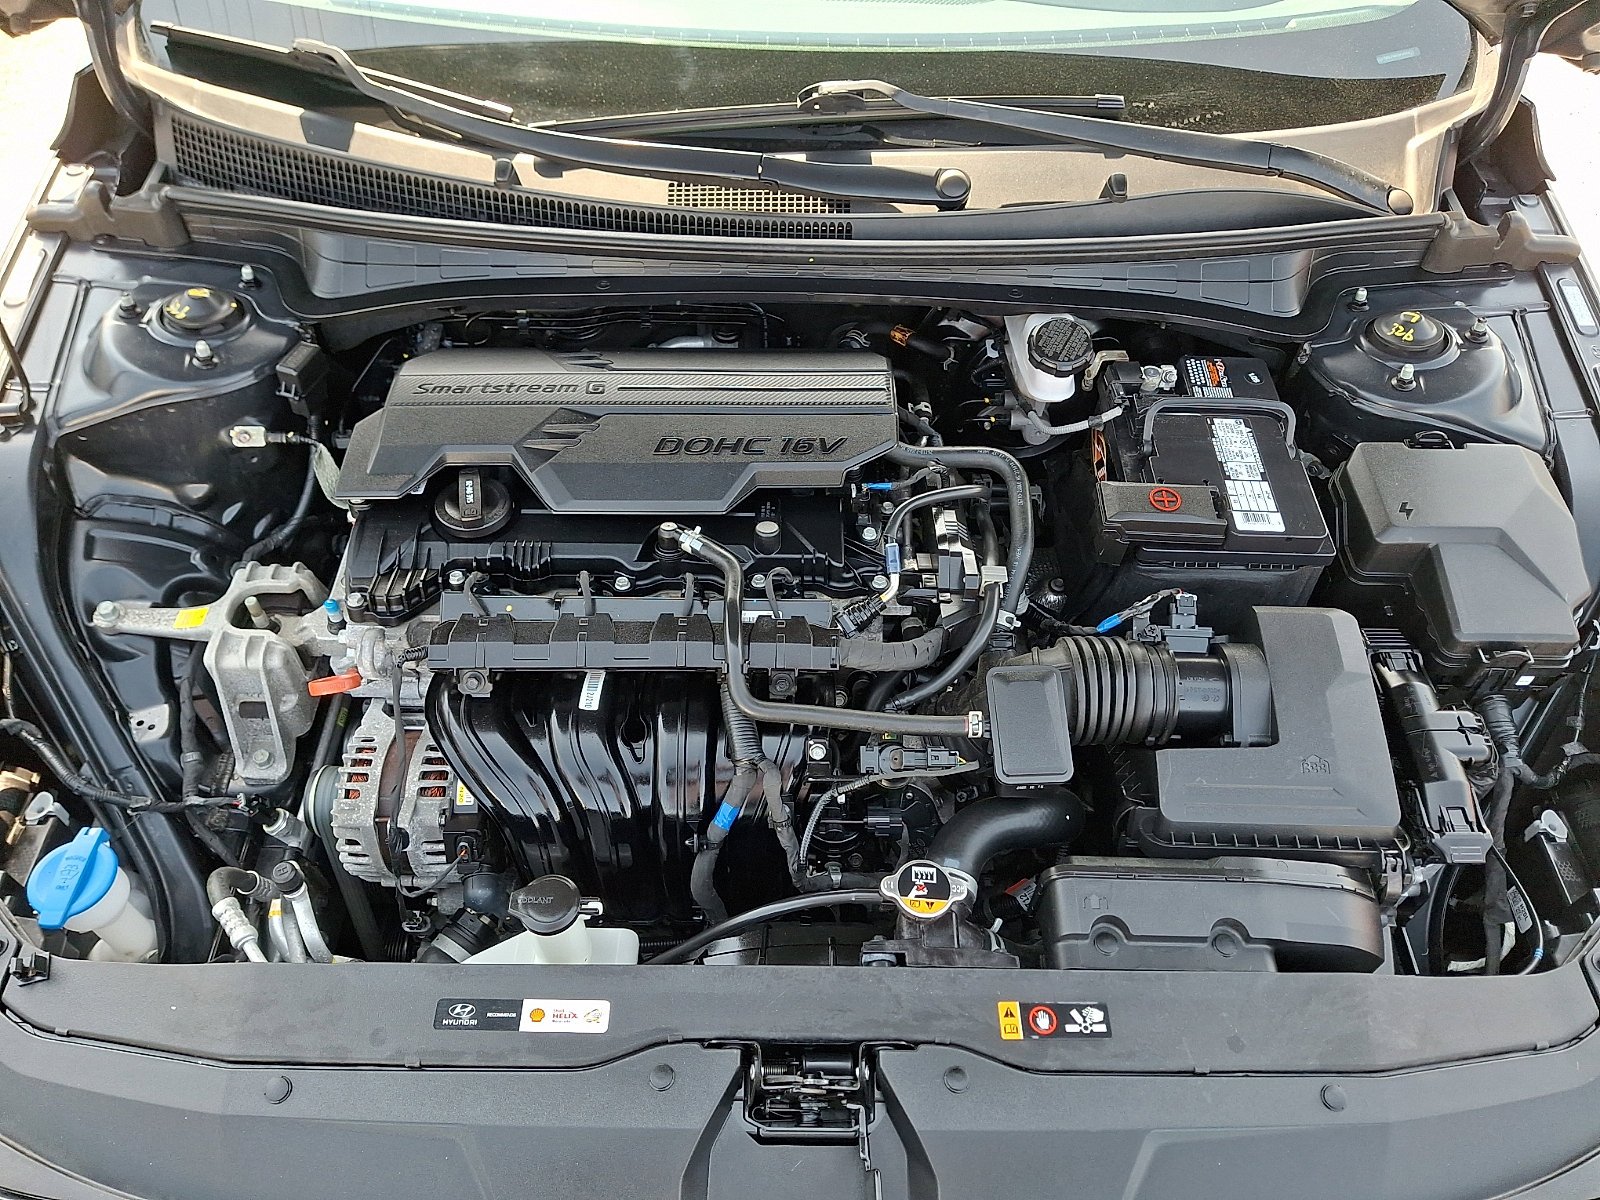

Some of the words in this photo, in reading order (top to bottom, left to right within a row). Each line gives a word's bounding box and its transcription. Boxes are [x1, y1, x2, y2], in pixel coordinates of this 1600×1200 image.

[412, 383, 578, 394] Smartstream
[653, 437, 772, 455] DOHC
[780, 437, 848, 455] 16V
[552, 1011, 578, 1019] HELIX
